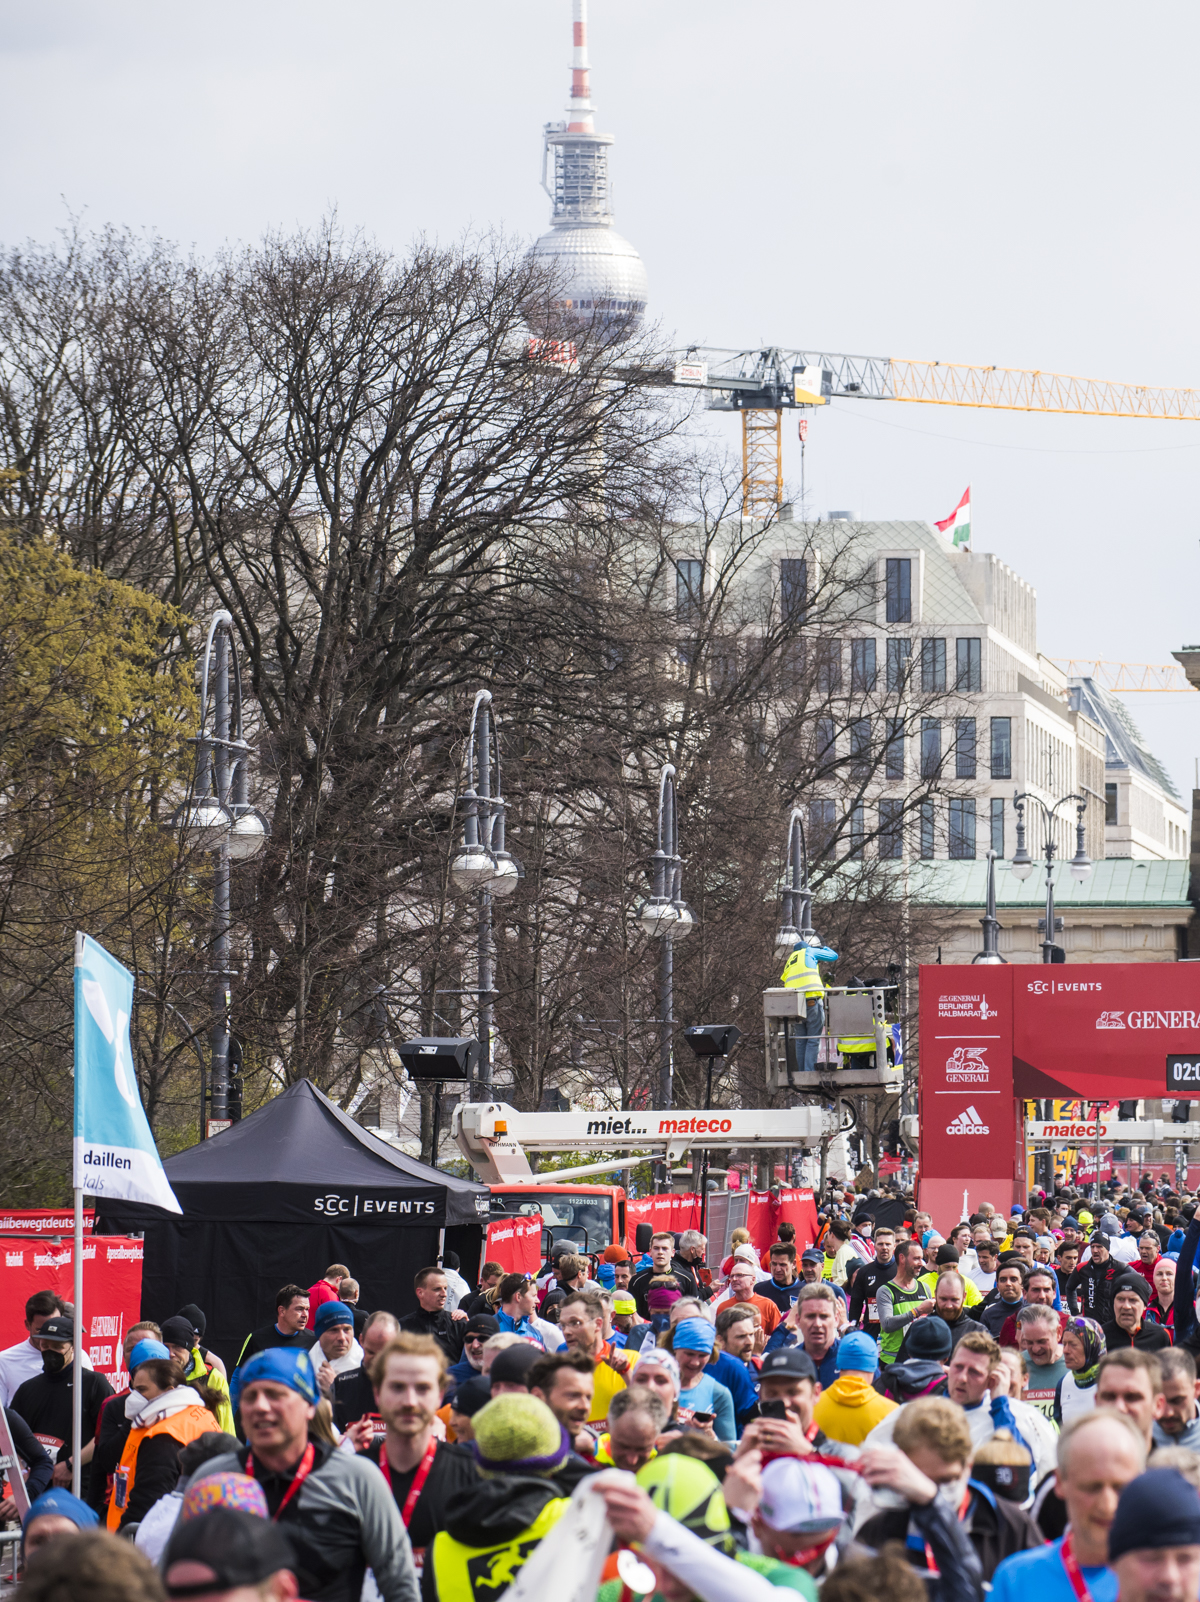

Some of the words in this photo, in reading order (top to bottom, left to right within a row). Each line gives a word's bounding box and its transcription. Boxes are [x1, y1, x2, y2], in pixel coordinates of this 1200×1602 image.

[1027, 980, 1049, 994] SCC
[1057, 982, 1102, 992] EVENTS
[946, 1074, 989, 1083] GENERALI
[658, 1116, 732, 1134] mateco
[946, 1123, 990, 1135] adidas
[1042, 1123, 1107, 1137] mateco
[83, 1149, 132, 1170] daillen
[313, 1194, 349, 1216] SCC
[363, 1200, 435, 1214] EVENTS
